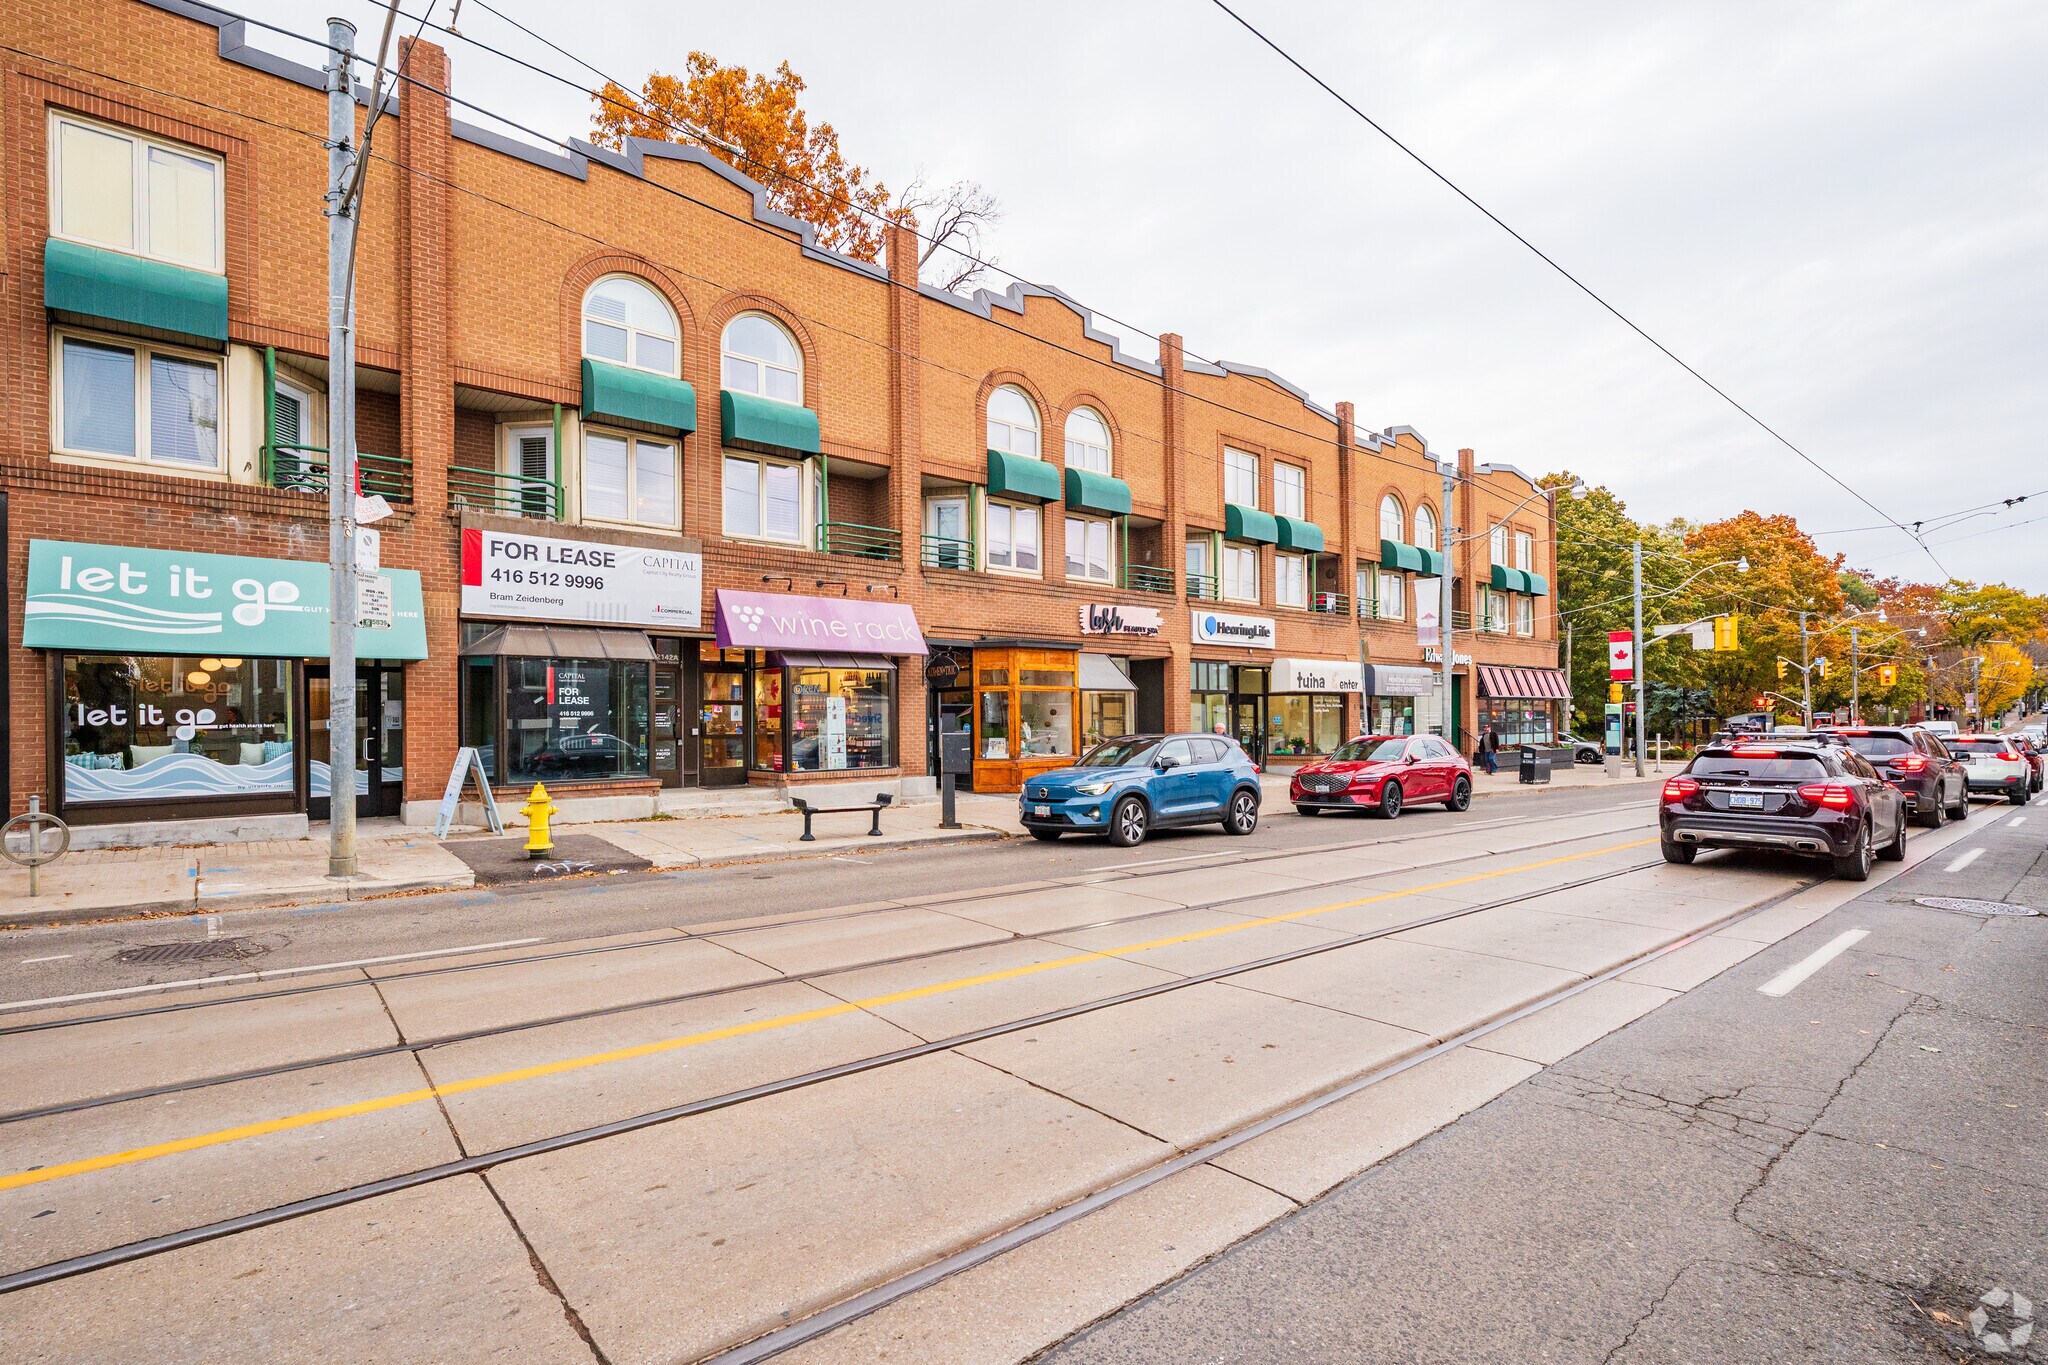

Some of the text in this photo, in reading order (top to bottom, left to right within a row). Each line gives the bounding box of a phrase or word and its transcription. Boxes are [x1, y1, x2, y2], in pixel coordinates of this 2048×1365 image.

[490, 540, 616, 569] FOR LEASE
[642, 555, 697, 571] CAPITAL
[490, 568, 604, 590] 416 512 9996
[60, 555, 300, 627] let it go
[489, 592, 564, 606] Bram Zeidenberg
[660, 608, 693, 616] COMMERCIAL
[770, 611, 918, 642] wine rack
[1216, 621, 1271, 639] HearingLife
[656, 653, 680, 661] 2142A
[1451, 650, 1473, 666] Jones
[558, 672, 586, 680] CAPITAL
[1296, 671, 1325, 689] tuina
[558, 687, 579, 696] FOR
[558, 696, 590, 705] LEASE
[78, 703, 217, 741] let it go
